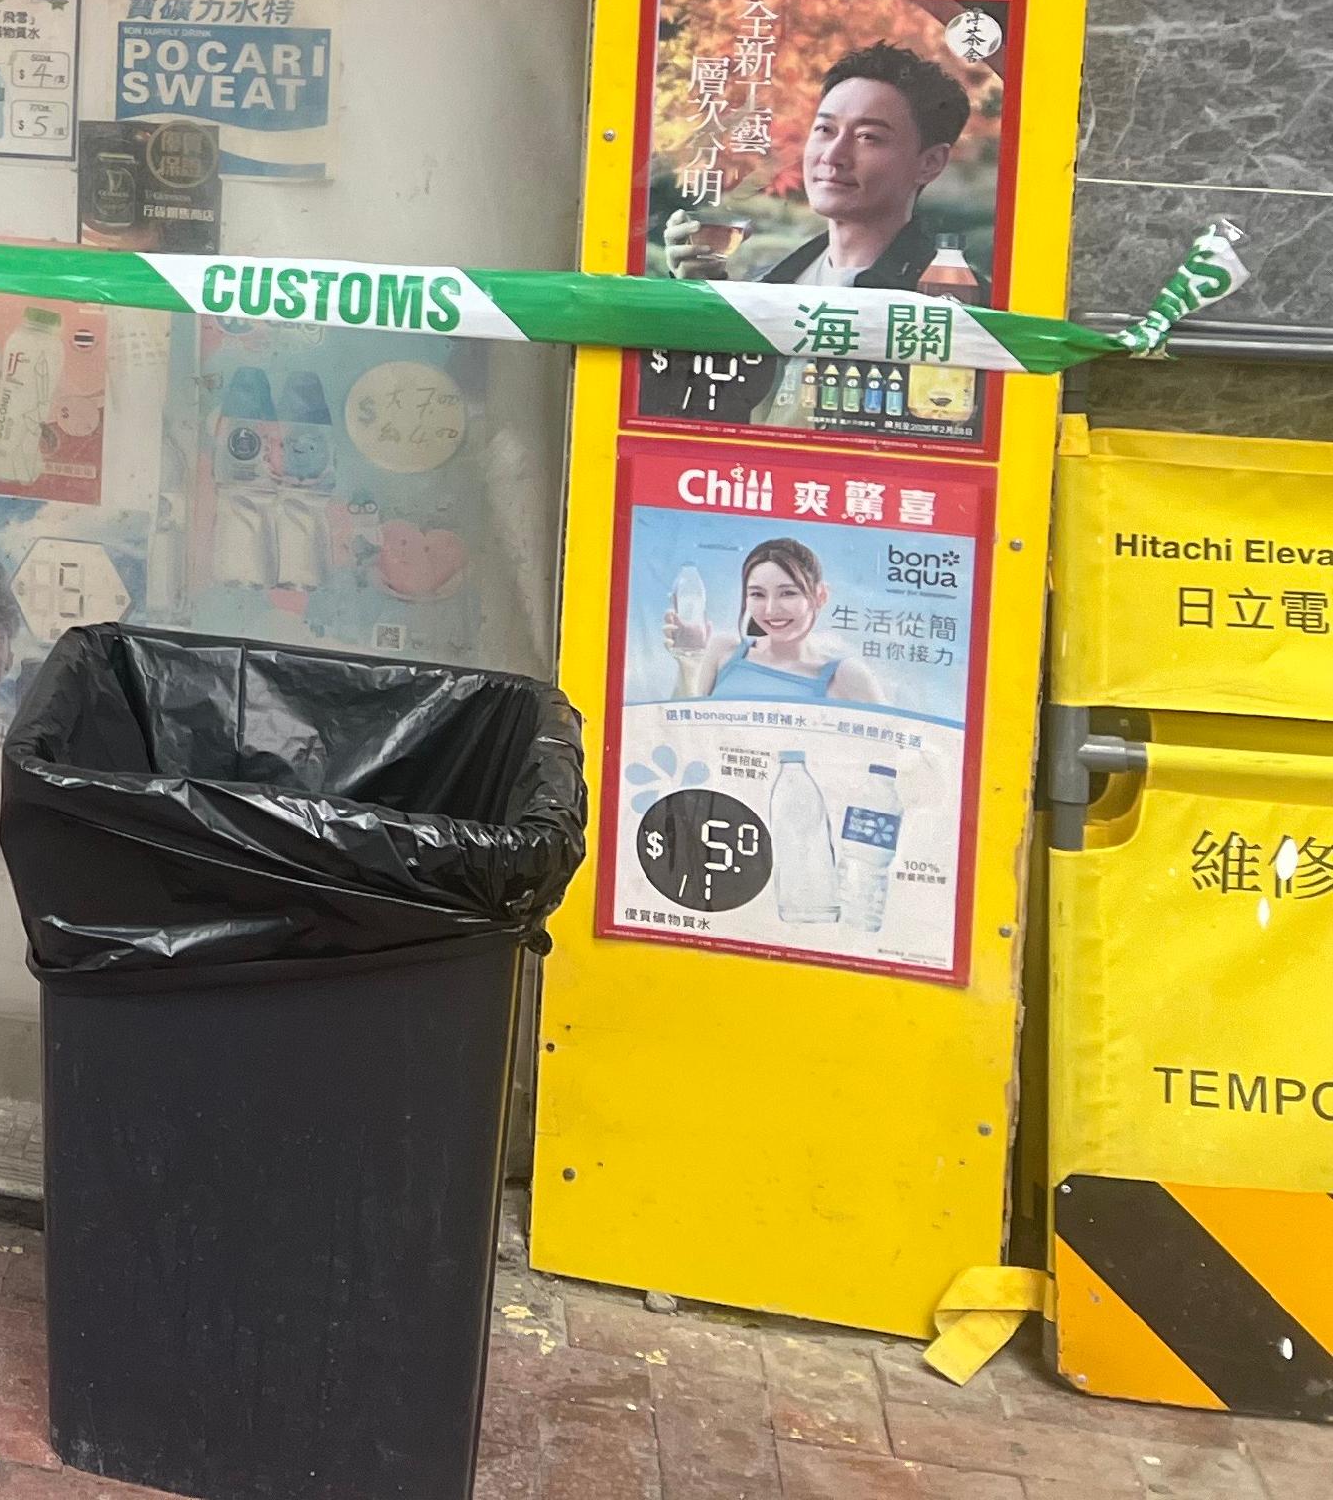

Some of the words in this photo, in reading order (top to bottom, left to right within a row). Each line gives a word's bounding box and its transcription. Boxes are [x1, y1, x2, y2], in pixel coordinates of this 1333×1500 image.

[31, 62, 54, 89] 4
[122, 39, 325, 77] POCARI
[122, 72, 306, 112] SWEAT
[729, 0, 779, 156] 全新工藝
[32, 114, 51, 138] 5
[680, 55, 730, 207] 層次分明
[201, 263, 462, 333] CUSTOMS
[793, 301, 955, 363] 海關
[649, 348, 669, 373] $
[677, 463, 773, 513] Chill
[792, 478, 935, 526] 爽驚喜
[887, 544, 940, 567] bon
[1114, 532, 1233, 562] Hitachi
[1244, 538, 1333, 567] Eleva
[886, 566, 958, 590] aqua
[829, 604, 957, 643] 生活從簡
[1177, 586, 1331, 635] 日立電
[862, 640, 954, 667] 由你接力
[645, 829, 665, 860] $
[903, 860, 941, 874] 100%
[1190, 827, 1333, 901] 維修
[623, 906, 712, 933] 優質礦物質水
